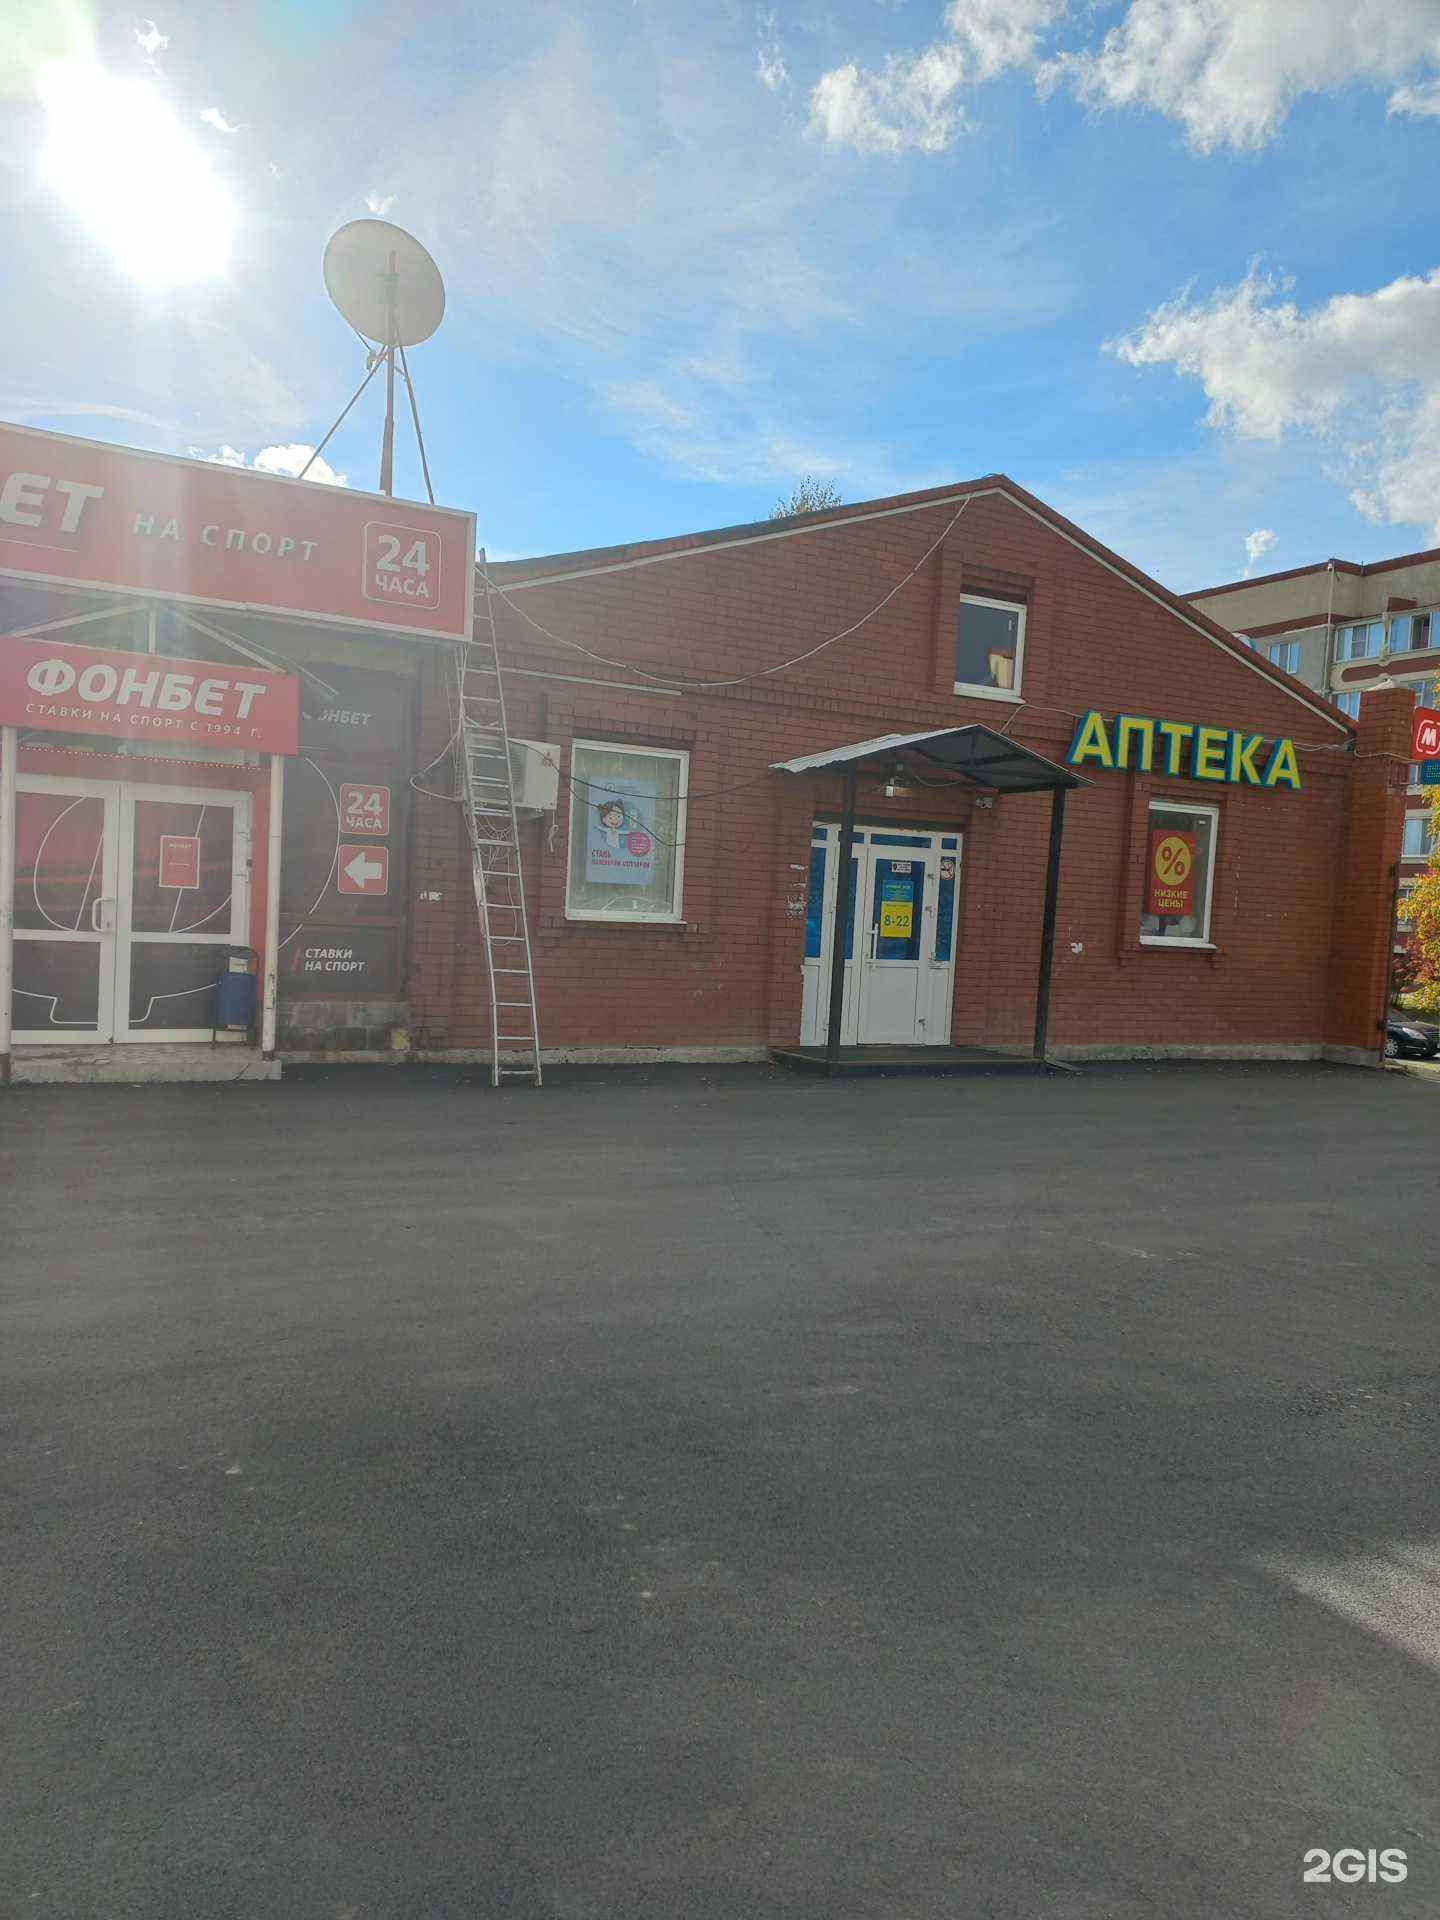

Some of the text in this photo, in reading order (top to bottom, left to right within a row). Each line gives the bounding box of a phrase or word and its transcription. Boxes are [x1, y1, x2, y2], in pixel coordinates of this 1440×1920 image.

[132, 512, 319, 561] НА СПОРТ
[376, 534, 431, 576] 24
[375, 574, 430, 598] ЧАСА
[26, 658, 267, 720] ФОНБЕТ
[25, 703, 93, 719] СТАВКИ
[100, 711, 122, 723] НА
[130, 714, 184, 730] СПОРТ
[206, 723, 241, 736] 1994
[1067, 710, 1301, 789] АПТЕКА
[347, 791, 383, 815] 24
[346, 816, 383, 829] ЧАСА
[1154, 888, 1189, 899] НИЗКИЕ
[1158, 899, 1184, 909] ЦЕНЫ
[305, 948, 353, 959] СТАВКИ
[304, 961, 366, 972] НА СПОРТ
